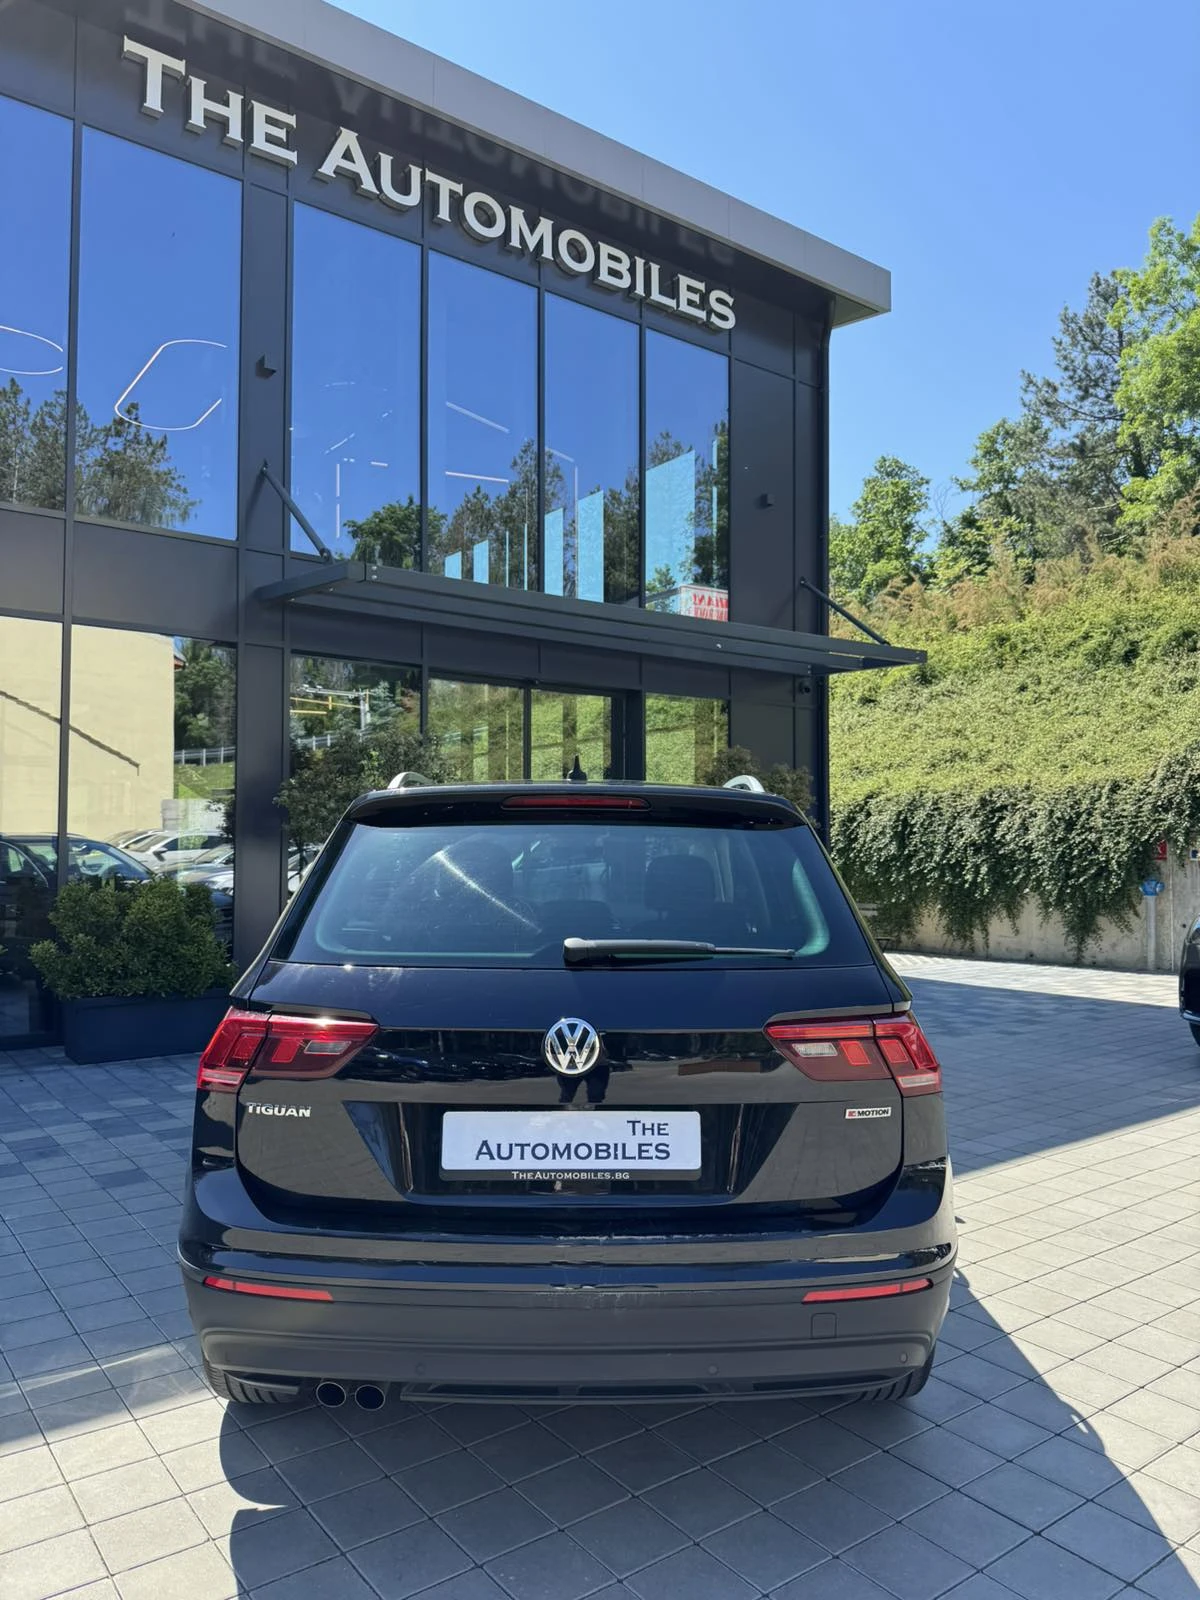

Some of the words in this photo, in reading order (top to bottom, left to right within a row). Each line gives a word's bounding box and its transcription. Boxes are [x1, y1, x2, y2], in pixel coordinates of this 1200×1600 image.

[122, 34, 298, 167] THE
[314, 126, 737, 331] AUTOMOBILES
[546, 1018, 599, 1074] VW
[246, 1102, 312, 1118] TIGUAN
[626, 1119, 670, 1137] THE
[474, 1139, 671, 1161] AUTOMOBILES
